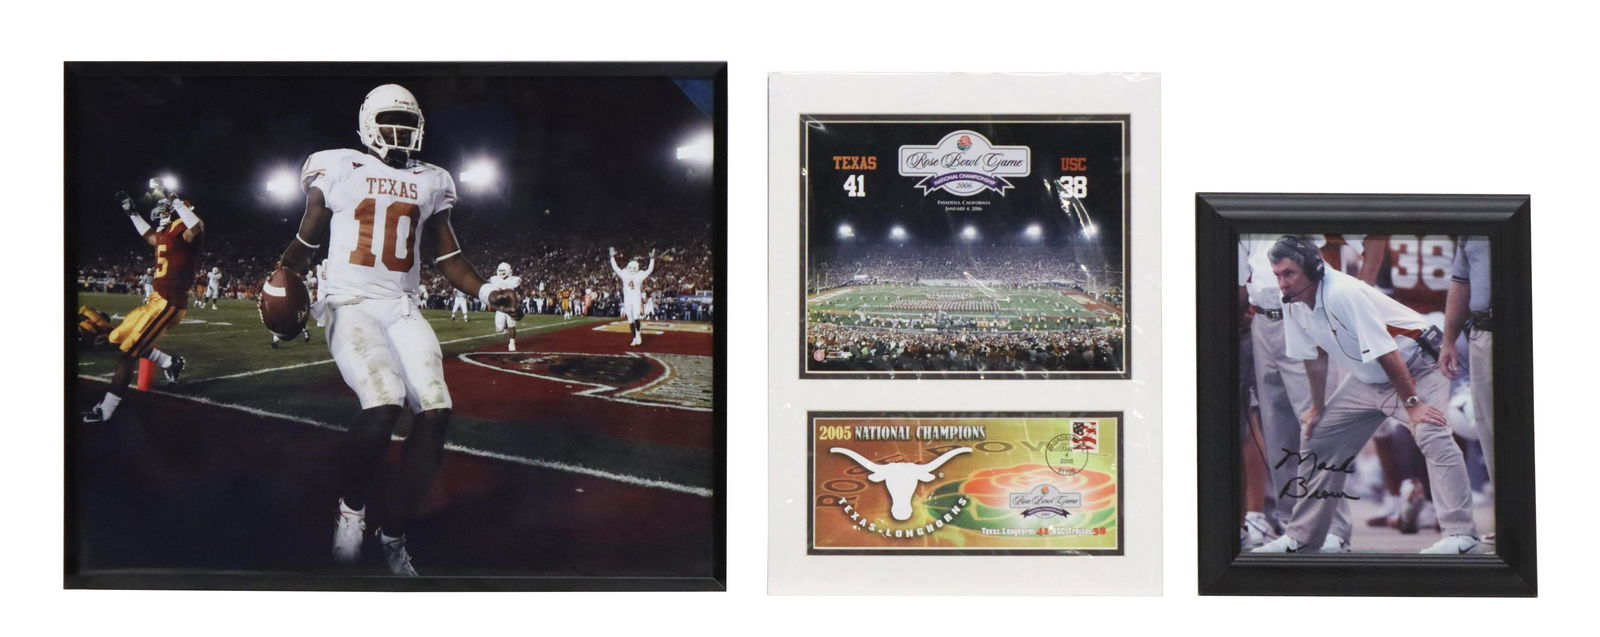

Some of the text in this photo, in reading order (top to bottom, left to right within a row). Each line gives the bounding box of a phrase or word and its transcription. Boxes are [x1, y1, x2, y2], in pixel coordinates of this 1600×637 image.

[833, 155, 878, 170] TEXAS
[906, 152, 1023, 172] Rose Bowl Game
[1060, 157, 1088, 171] USC
[843, 174, 866, 197] 41
[933, 173, 997, 186] NATIONAL CHAMPIONSHIP
[956, 182, 973, 190] 2006
[1059, 175, 1088, 198] 38
[366, 177, 419, 200] TEXAS
[348, 197, 421, 273] 10
[1390, 235, 1455, 290] 38
[628, 280, 636, 289] 4
[819, 425, 986, 441] 2005 NATIONAL CHAMPIONS
[981, 527, 1000, 536] Texas
